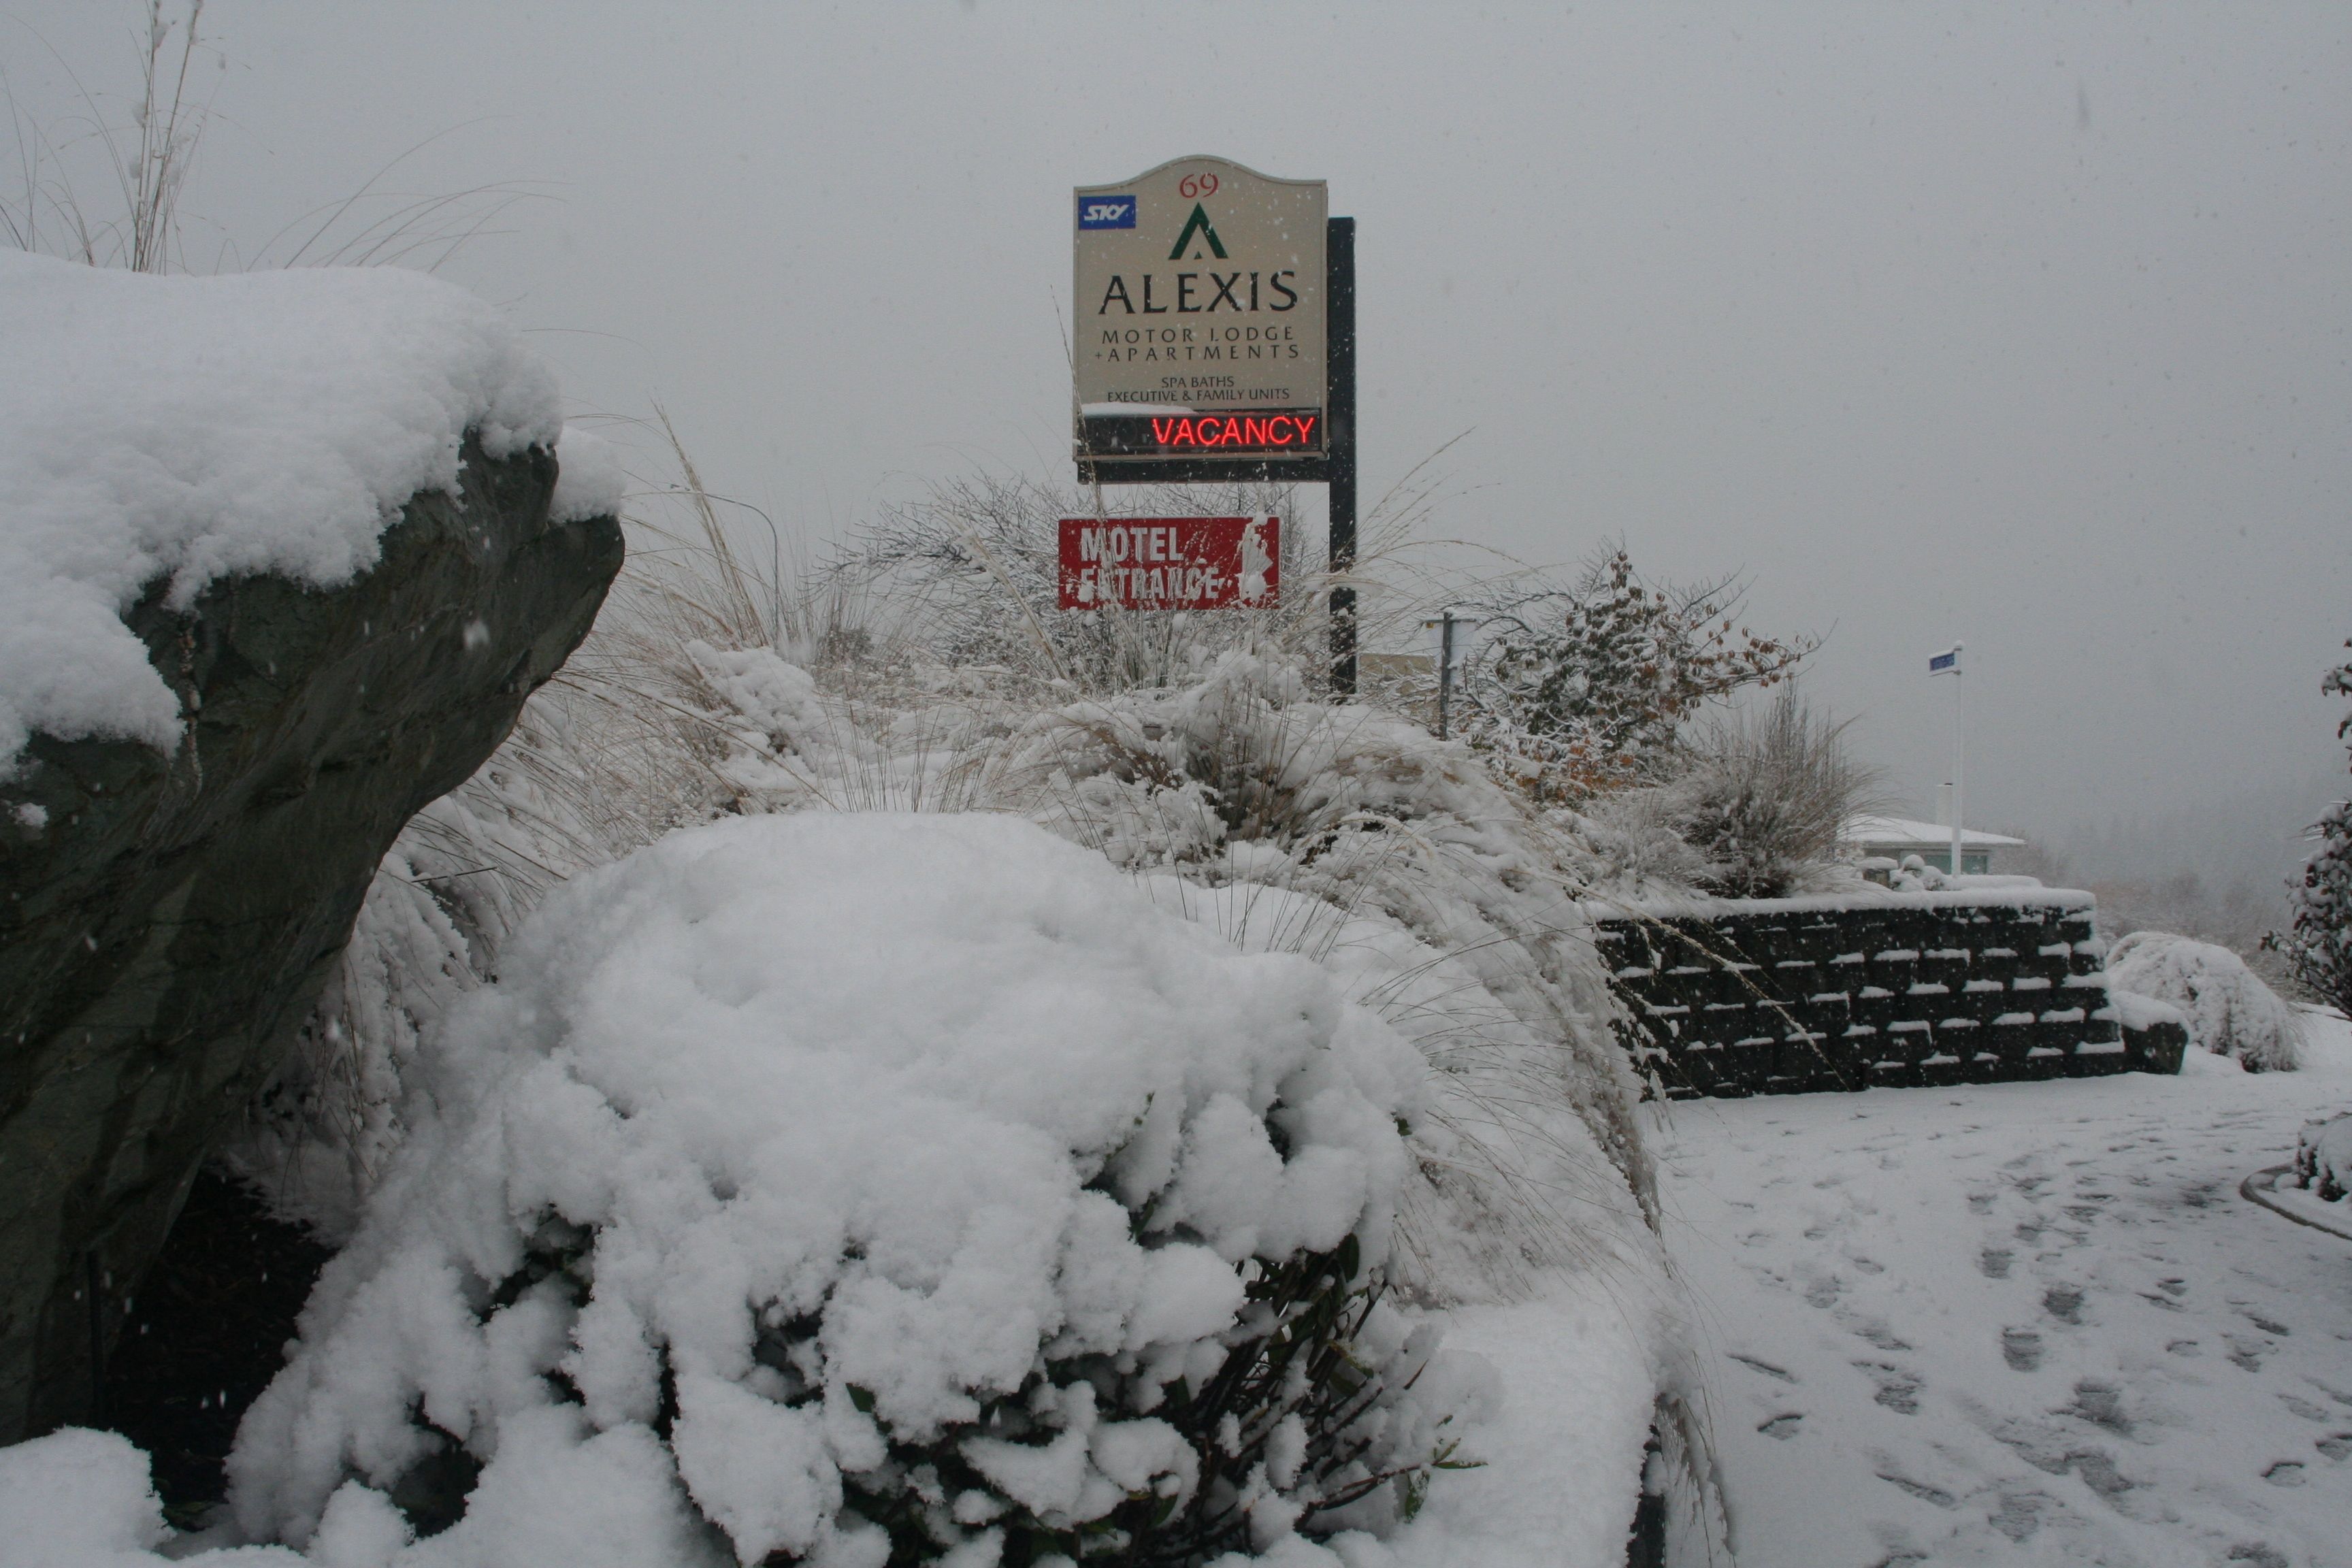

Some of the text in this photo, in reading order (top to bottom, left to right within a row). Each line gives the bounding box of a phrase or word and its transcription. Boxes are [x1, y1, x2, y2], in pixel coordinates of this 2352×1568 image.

[1179, 173, 1219, 198] 69
[1083, 204, 1130, 221] SKY
[1098, 270, 1298, 314] ALEXIS
[1102, 326, 1294, 344] MOTOR LODGE
[1161, 376, 1235, 389] SPA BATHS
[1107, 388, 1290, 403] EXECUTIVE & FAMILY UNITS
[1151, 415, 1316, 446] VACANCY
[1080, 526, 1185, 562] MOTEL
